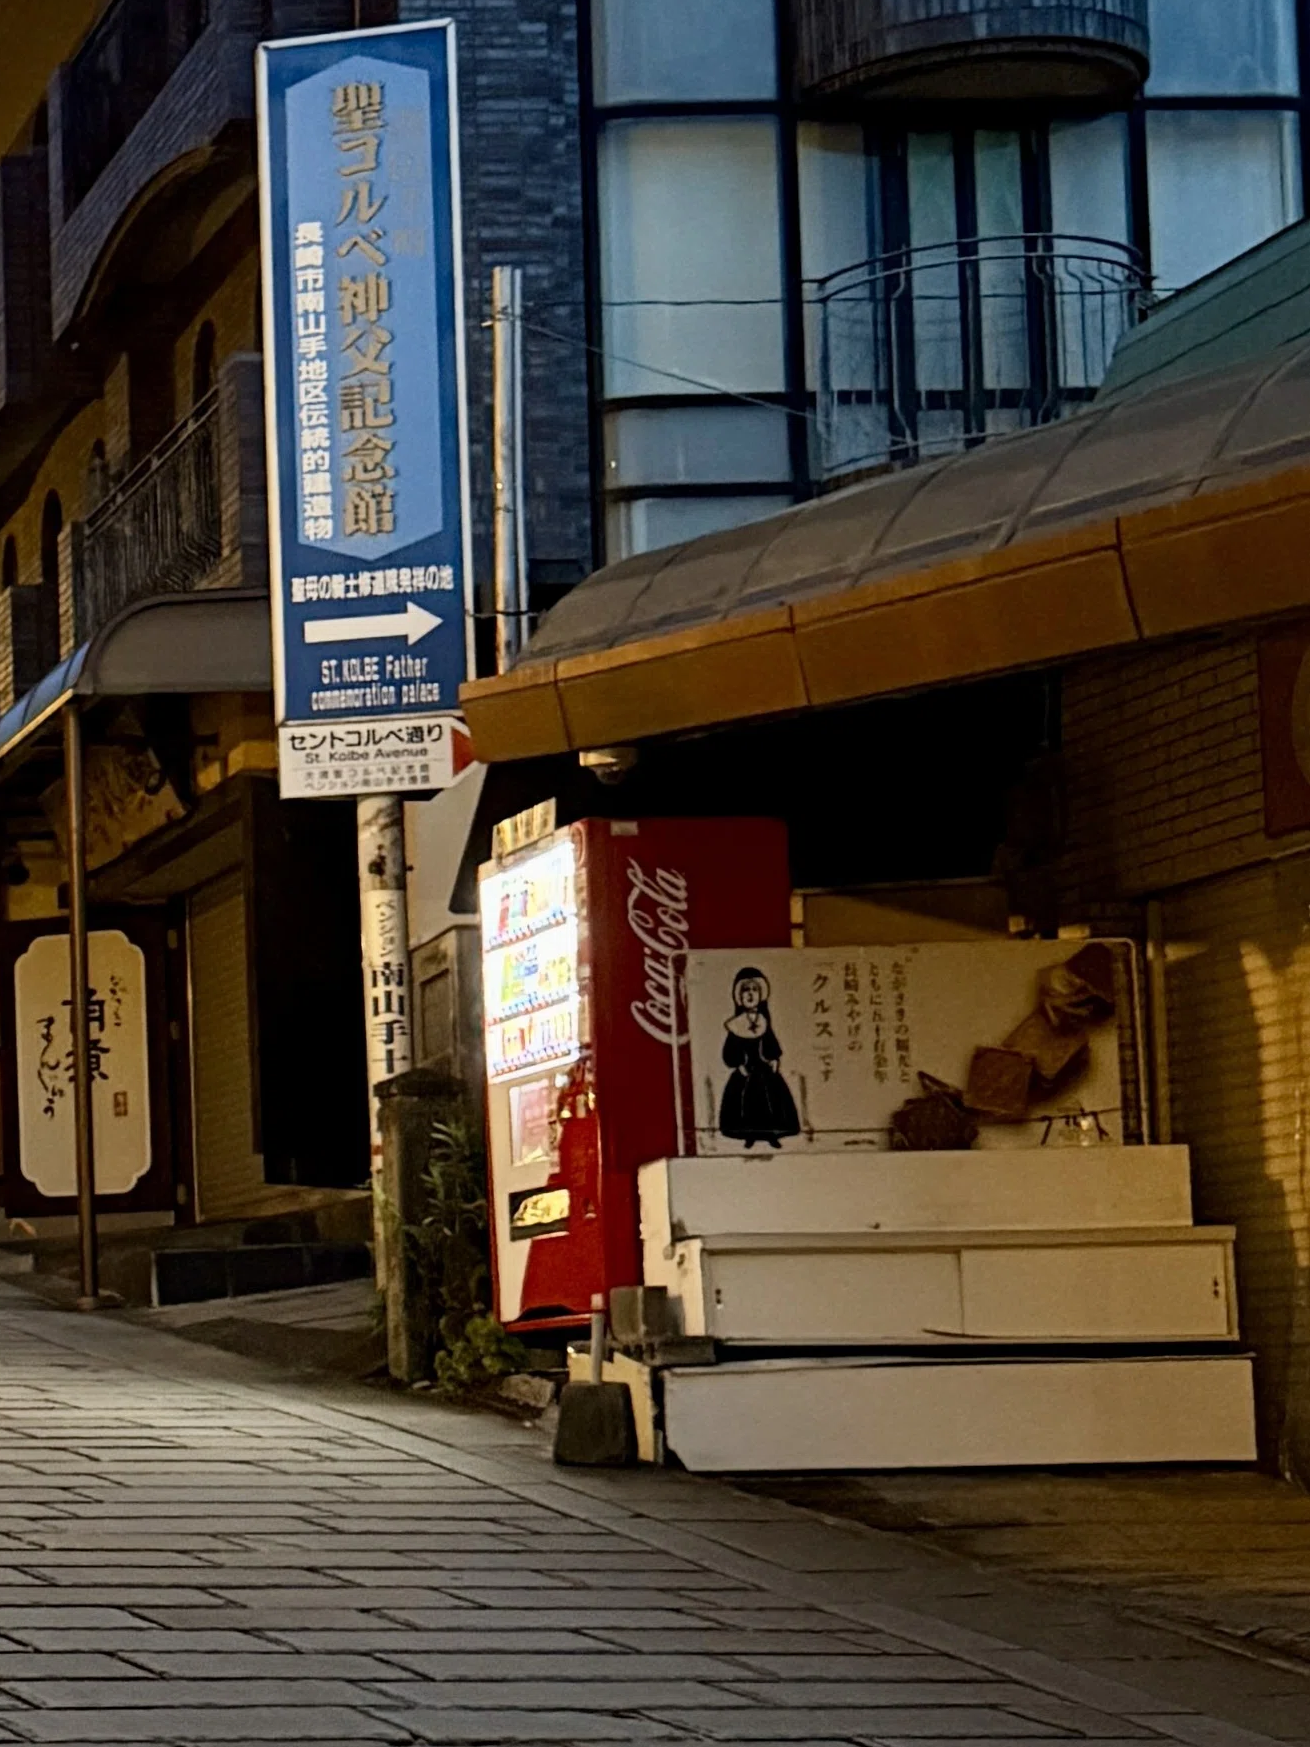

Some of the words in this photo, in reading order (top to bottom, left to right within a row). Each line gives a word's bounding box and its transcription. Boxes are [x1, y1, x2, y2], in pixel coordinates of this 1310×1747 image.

[332, 81, 398, 537] 聖コルベ神父記念館
[294, 221, 333, 541] 長崎市南山手地区伝統的建造物
[291, 565, 454, 603] 聖母の騎士修道院発祥の地
[321, 659, 340, 684] ST.
[342, 656, 379, 683] KOLBE
[386, 654, 428, 680] Father
[289, 723, 443, 751] セントコルベ通り
[329, 748, 369, 763] Kolbe
[374, 747, 428, 760] Avenue
[626, 856, 690, 1045] Coca-Cola
